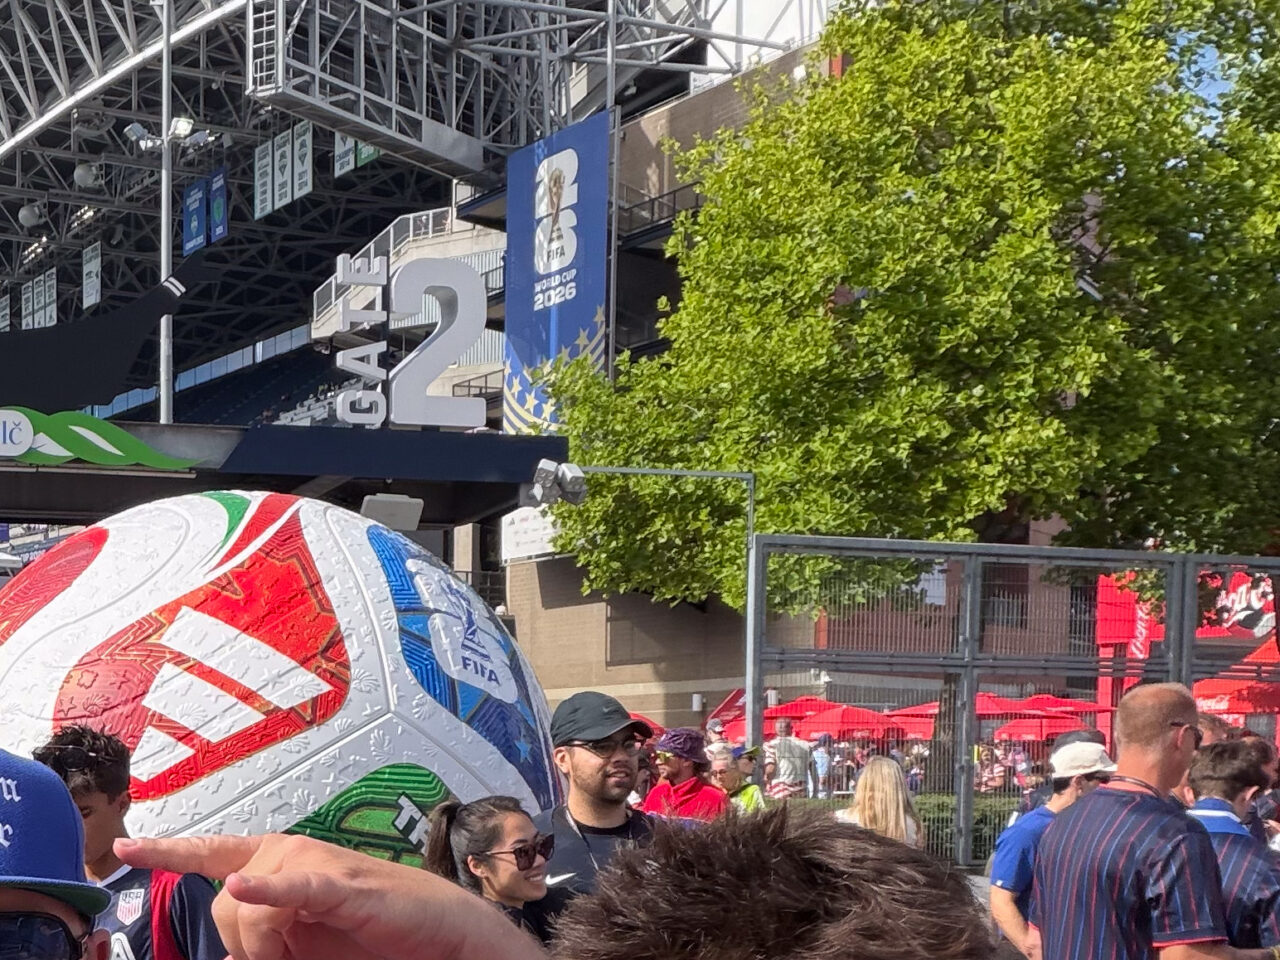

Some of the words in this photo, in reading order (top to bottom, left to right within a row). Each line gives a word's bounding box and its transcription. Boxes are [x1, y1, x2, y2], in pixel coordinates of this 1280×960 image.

[546, 247, 566, 264] FIFA
[534, 272, 562, 293] WORLD
[561, 268, 577, 284] CUP
[534, 282, 577, 311] 2026
[336, 253, 388, 428] GATE
[389, 257, 487, 427] 2
[461, 655, 501, 685] FIFA
